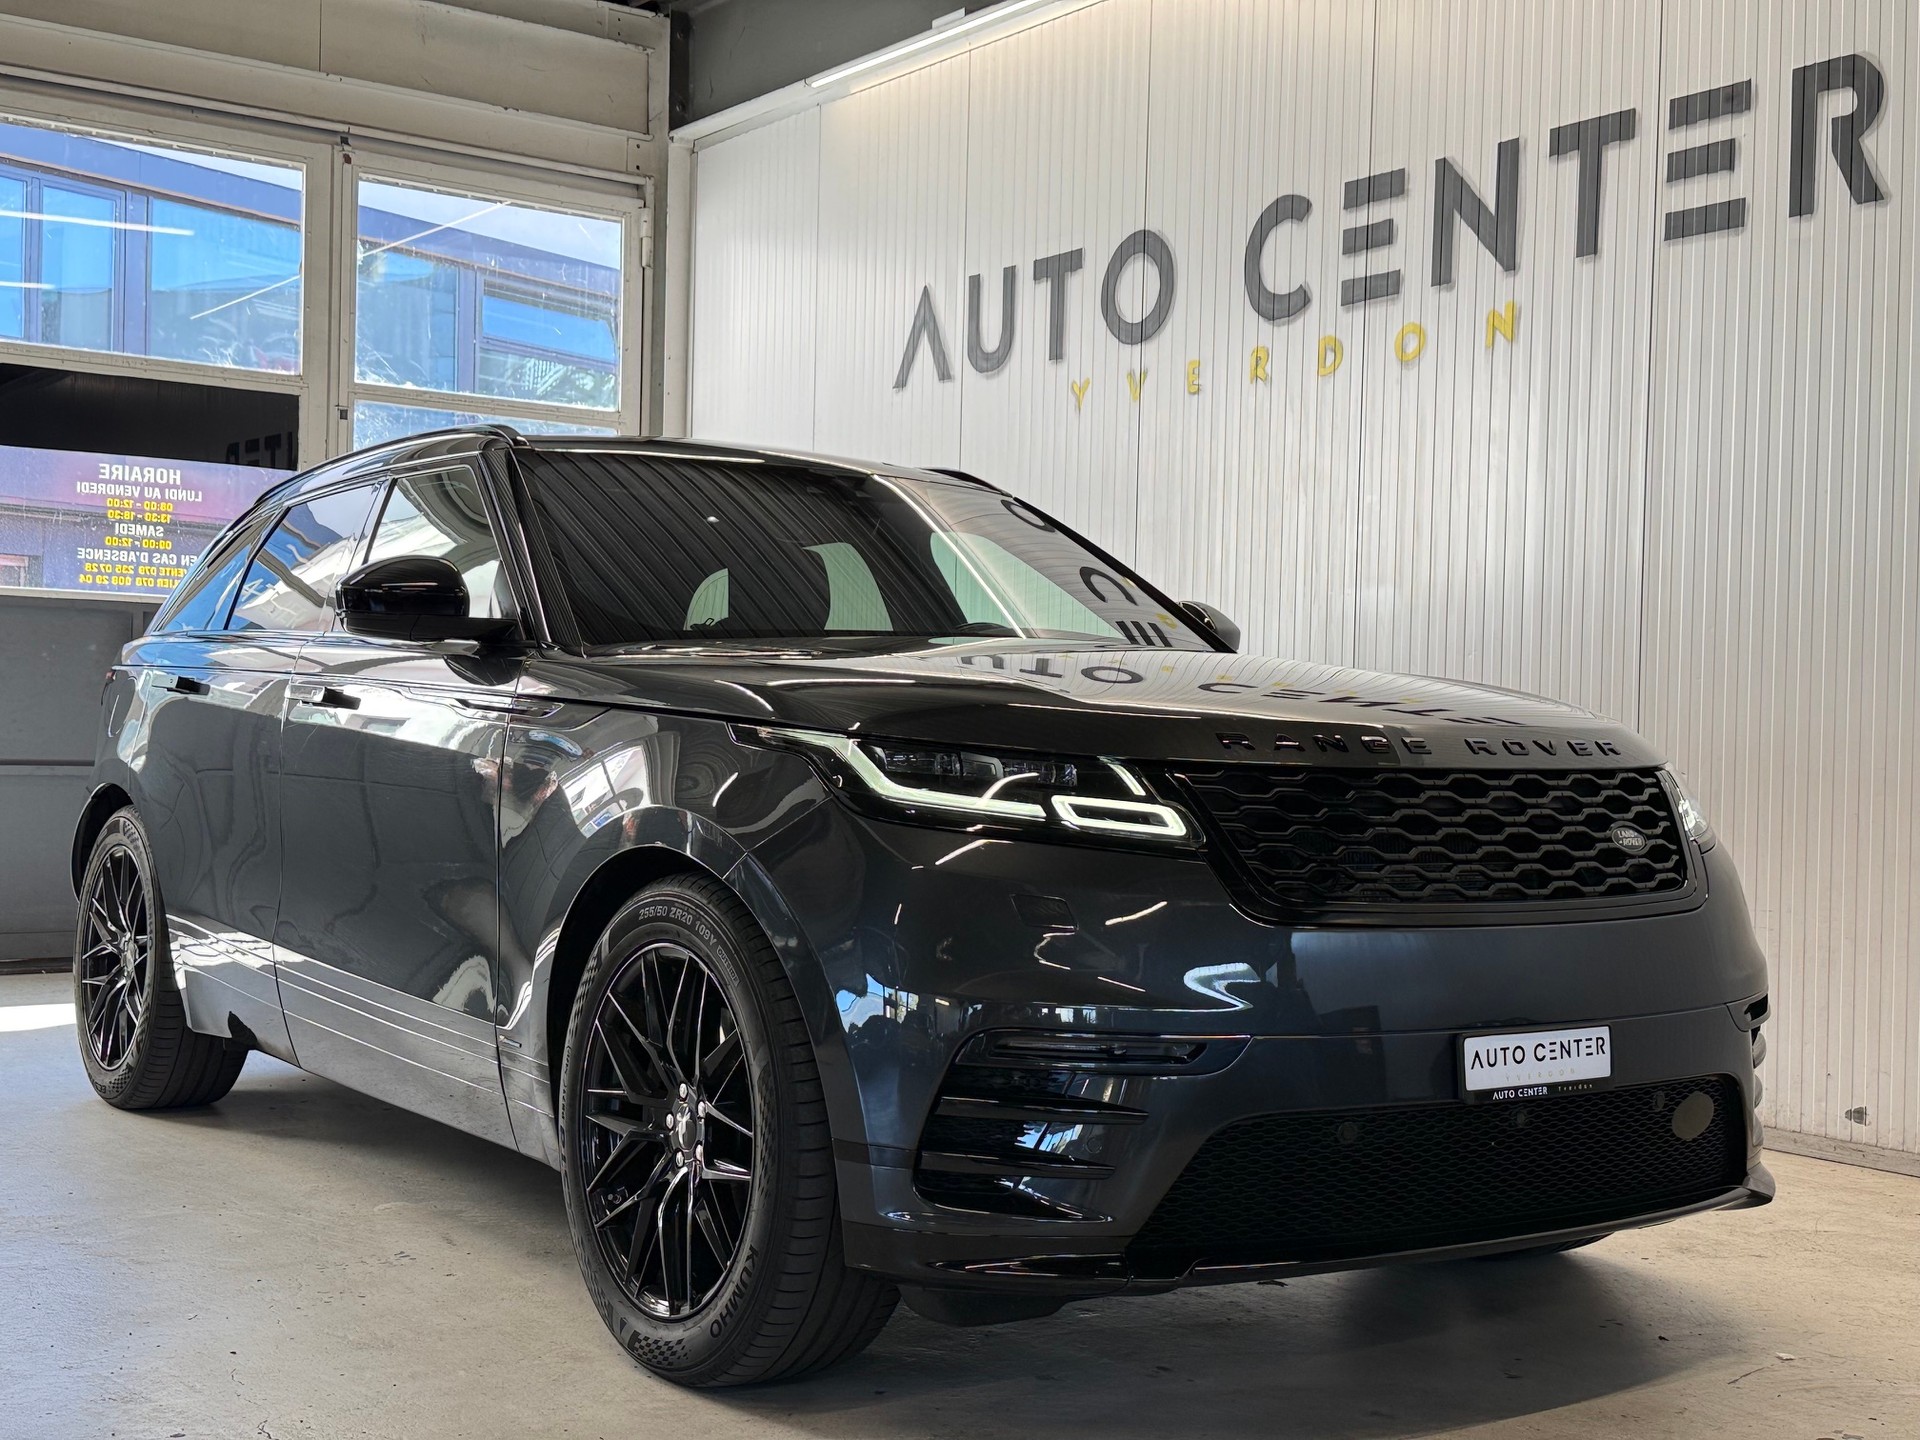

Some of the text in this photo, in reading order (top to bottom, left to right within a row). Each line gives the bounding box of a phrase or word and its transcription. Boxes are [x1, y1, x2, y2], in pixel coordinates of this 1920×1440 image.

[893, 54, 1887, 390] AUTO CENTER
[1071, 301, 1520, 411] YVERDON
[1215, 732, 1622, 757] RANGE ROVER
[638, 905, 667, 921] 255/50
[669, 907, 693, 926] ZR20
[1471, 1036, 1606, 1070] AUTO CENTER
[1492, 1089, 1515, 1100] AUTO
[1517, 1086, 1549, 1098] CENTER
[709, 1243, 760, 1339] KUMHO
